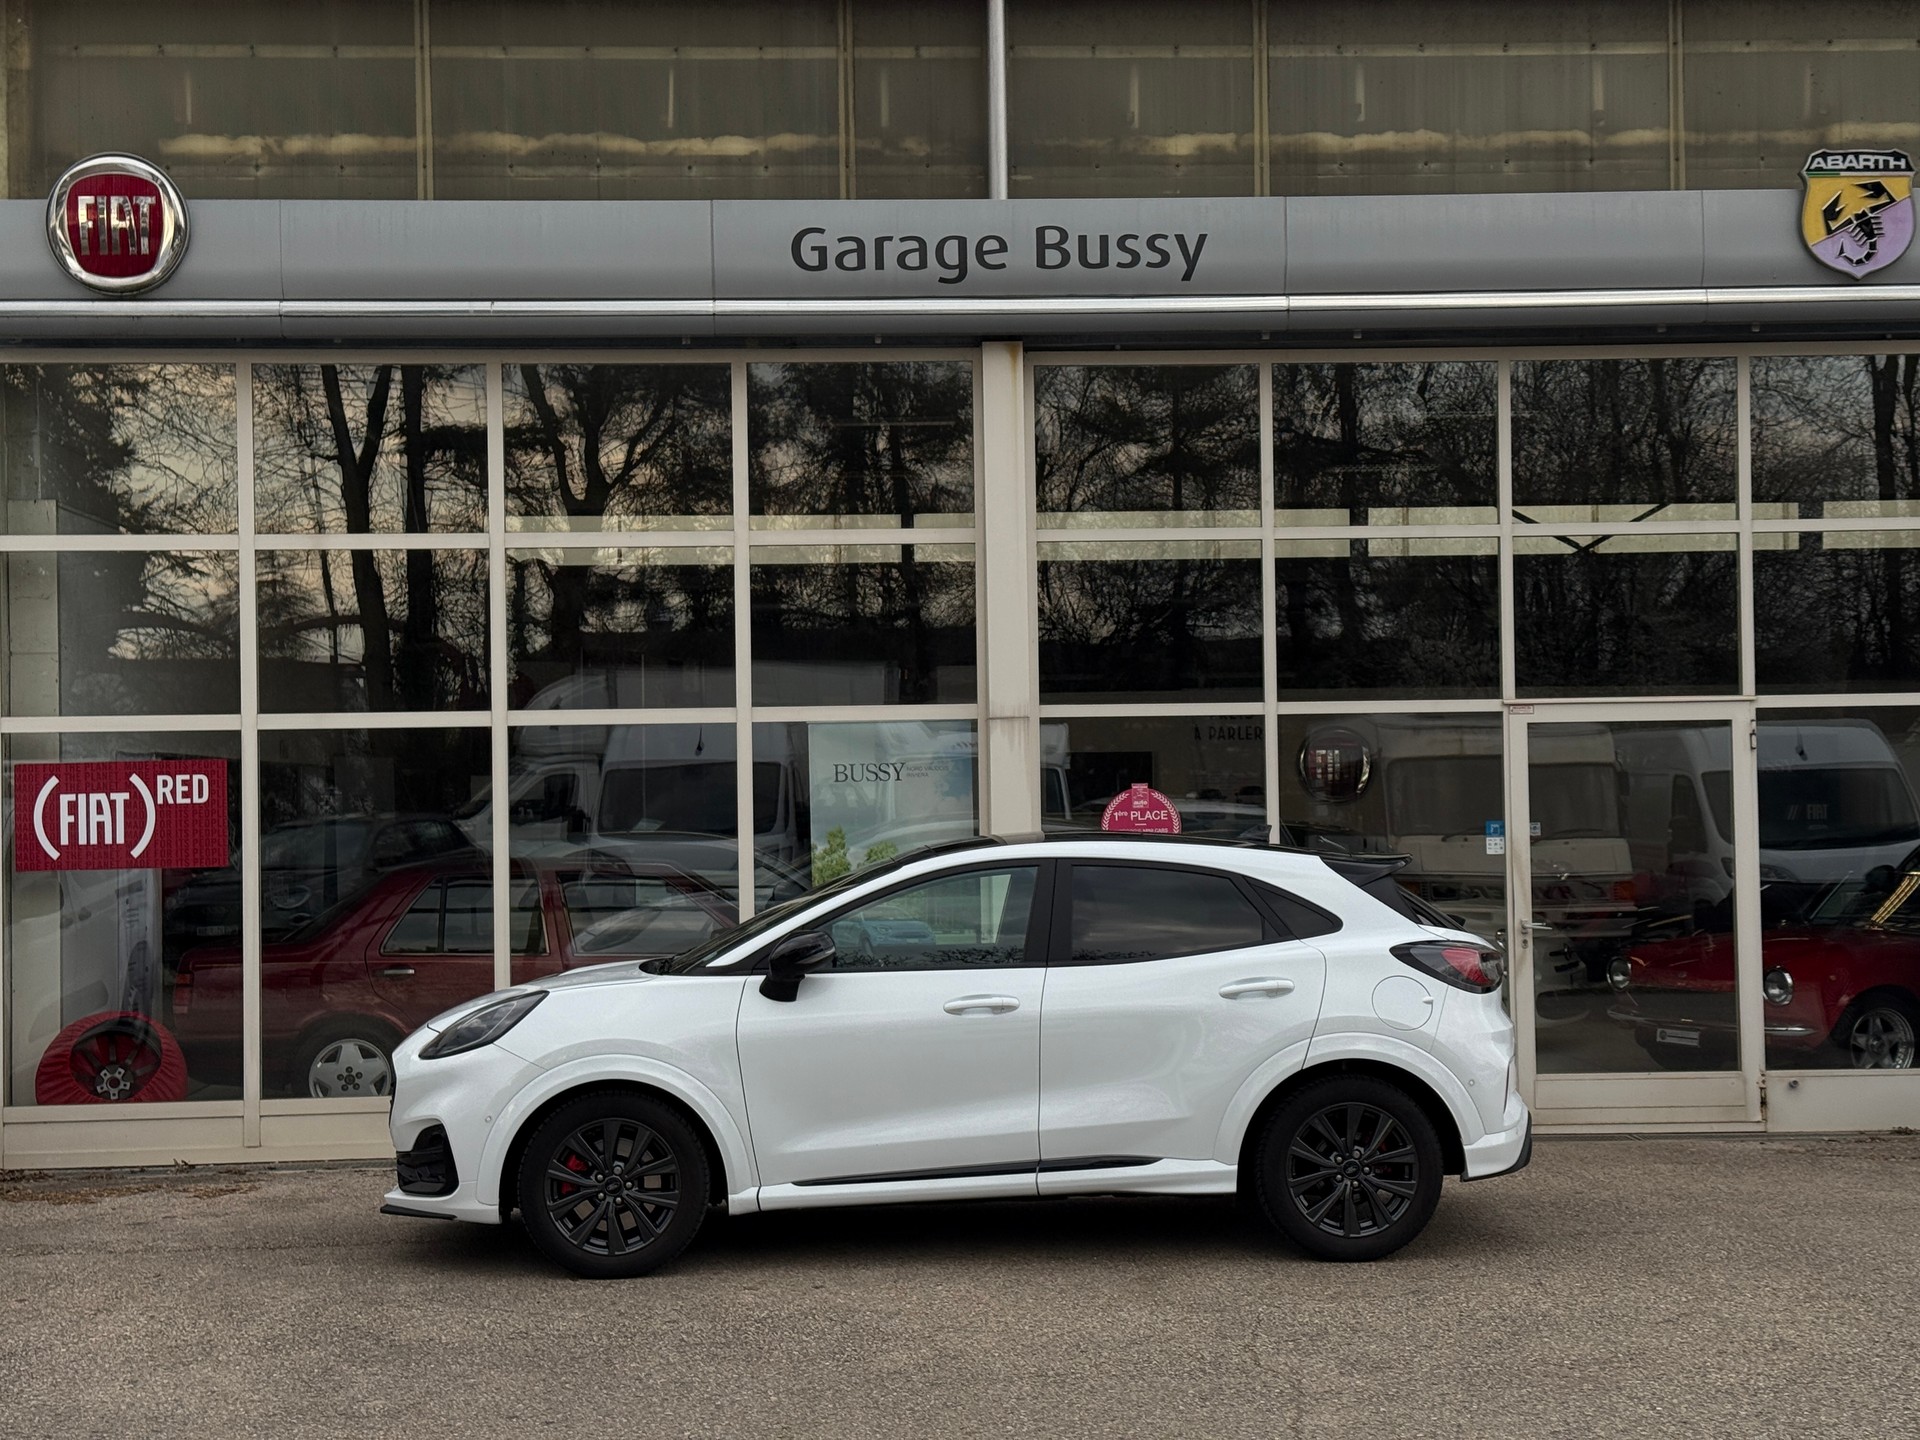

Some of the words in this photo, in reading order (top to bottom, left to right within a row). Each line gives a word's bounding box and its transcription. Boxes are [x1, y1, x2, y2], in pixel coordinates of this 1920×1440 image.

[1809, 154, 1907, 170] ABARTH
[77, 195, 156, 255] FIAT
[791, 227, 1008, 285] Garage
[1035, 225, 1208, 281] Bussy
[1208, 725, 1263, 740] PARLER
[833, 762, 906, 783] BUSSY
[157, 774, 209, 804] RED
[1130, 810, 1169, 821] PLACE
[1807, 803, 1828, 820] FIAT
